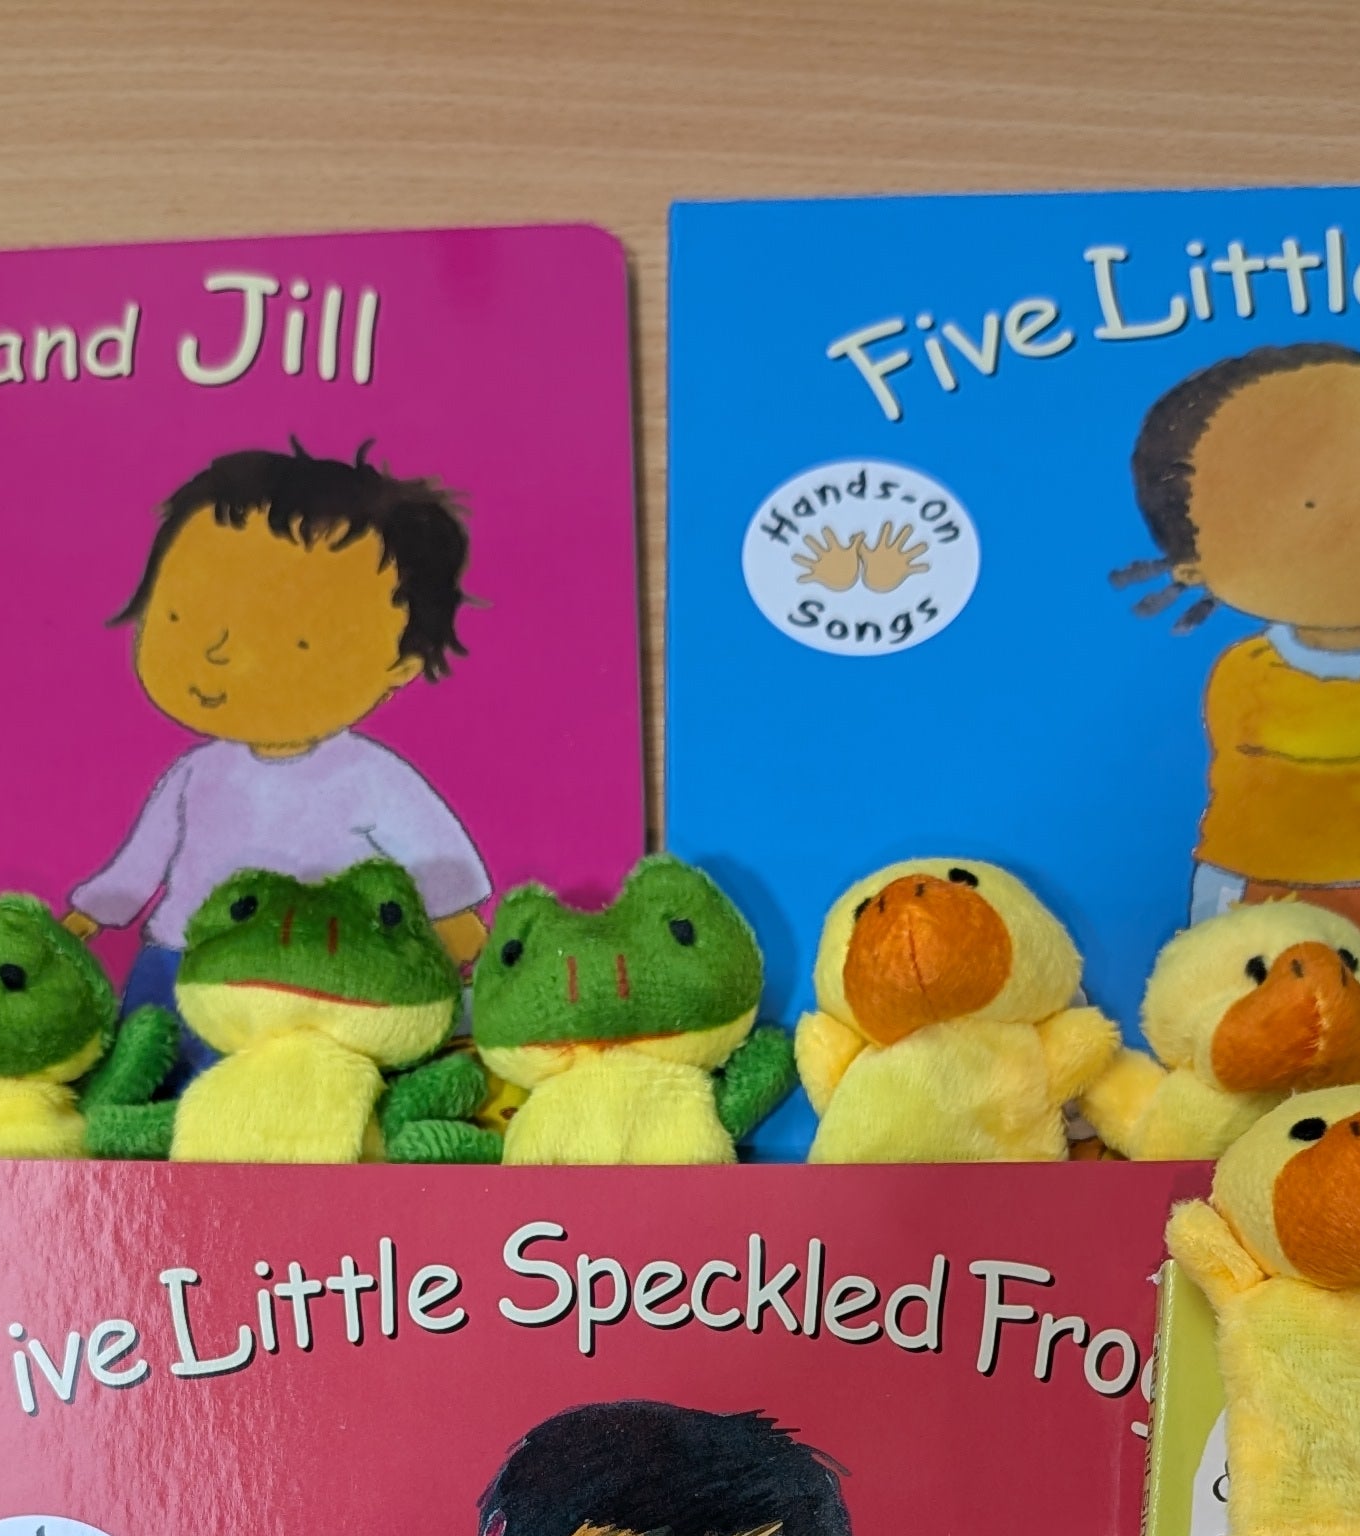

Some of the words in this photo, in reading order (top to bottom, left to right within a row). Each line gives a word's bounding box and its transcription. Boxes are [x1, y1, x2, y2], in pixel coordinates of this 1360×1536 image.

[177, 271, 382, 388] Jill
[826, 294, 1074, 420] Five
[787, 597, 939, 645] Songs
[159, 1237, 467, 1378] Little
[497, 1220, 948, 1355] Speckled
[969, 1259, 1154, 1440] Fro
